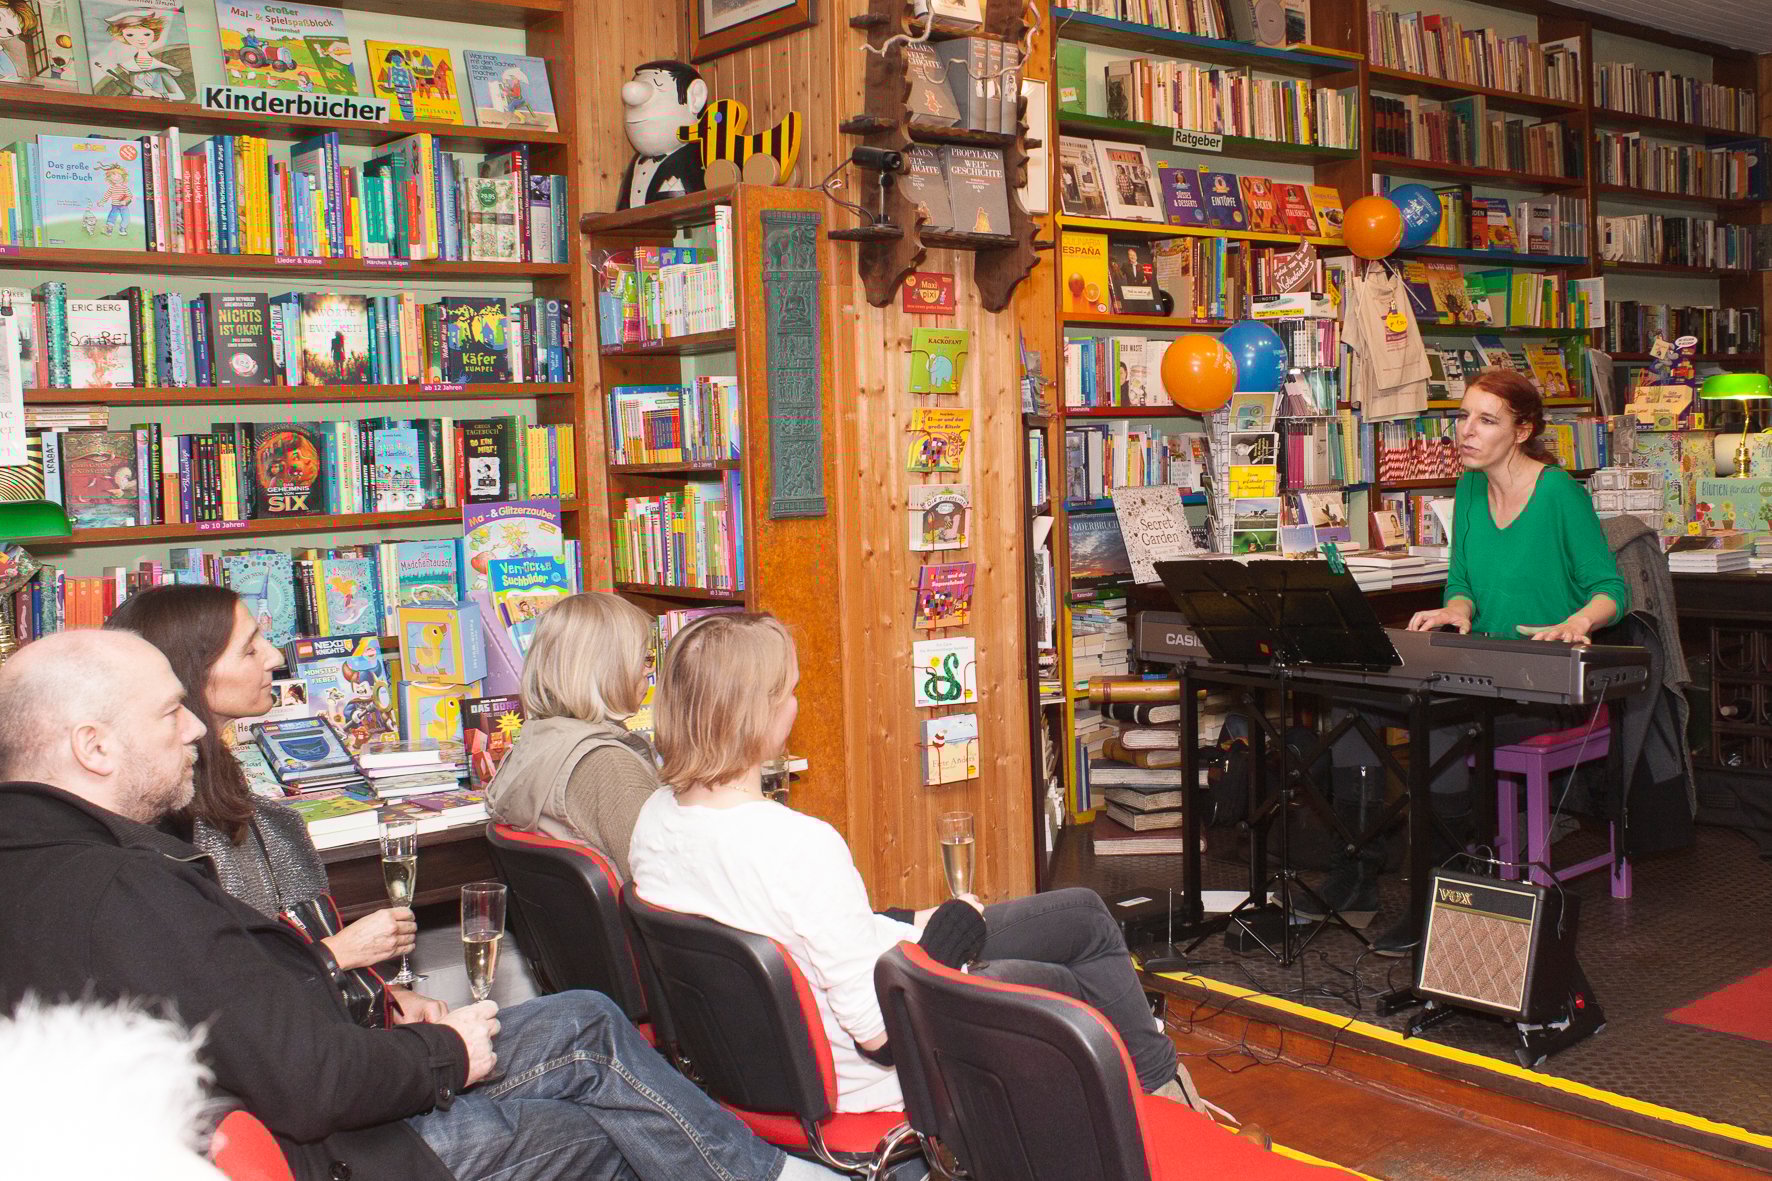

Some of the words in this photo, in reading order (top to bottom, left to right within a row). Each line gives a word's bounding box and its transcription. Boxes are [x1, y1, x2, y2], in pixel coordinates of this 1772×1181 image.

[264, 5, 299, 16] Großer
[230, 6, 253, 18] Mal-
[265, 15, 334, 28] Spielspaßblock
[494, 60, 518, 68] Sachen
[205, 87, 387, 122] Kinderbücher
[1174, 131, 1222, 149] Ratgeber
[951, 147, 999, 160] PROPYLÄEN
[48, 160, 64, 169] Das
[66, 161, 89, 171] große
[964, 159, 989, 169] WELT-
[45, 171, 93, 182] Conni-Buch
[951, 166, 1003, 178] GESCHICHTE
[1177, 199, 1198, 208] DESSERTS
[1211, 195, 1236, 207] EINTÖPFE
[1062, 245, 1101, 256] ESPAÑA
[921, 280, 938, 289] Maxi
[72, 303, 94, 312] ERIC
[96, 303, 121, 312] BERG
[218, 309, 262, 323] NICHTS
[219, 324, 235, 336] IST
[236, 324, 263, 336] OKAY!
[928, 337, 963, 345] KACKOFANT
[1129, 344, 1143, 352] WASTE
[462, 352, 497, 367] Käfer
[46, 442, 57, 474] KRABAT
[1702, 481, 1728, 496] BLUMEN
[268, 495, 309, 512] SIX
[490, 508, 499, 518] &
[499, 505, 557, 521] Glitzerzauber
[222, 521, 245, 529] Jahren
[1140, 516, 1174, 531] Secret
[1141, 529, 1180, 546] Garden
[400, 557, 453, 571] Mädchentausch
[501, 572, 549, 586] Suchbilder
[314, 640, 344, 649] NEXO
[1166, 633, 1202, 646] CASI
[315, 647, 345, 655] KNIGHTS
[311, 676, 337, 684] FIEBER
[1438, 887, 1473, 906] VOX
